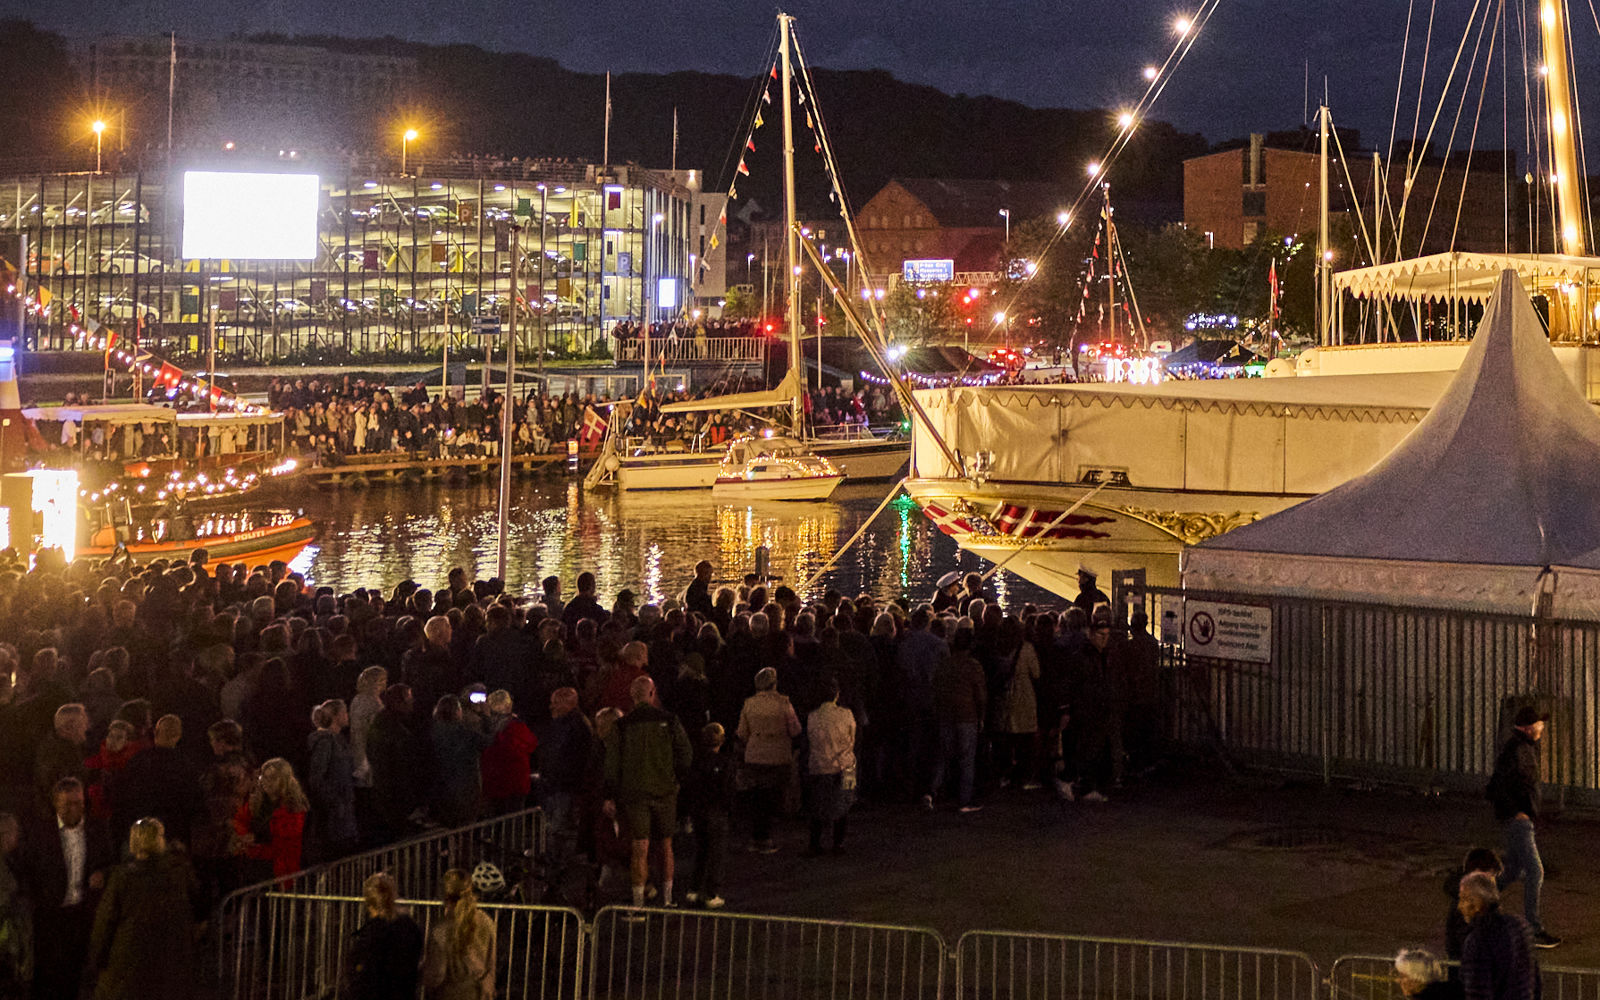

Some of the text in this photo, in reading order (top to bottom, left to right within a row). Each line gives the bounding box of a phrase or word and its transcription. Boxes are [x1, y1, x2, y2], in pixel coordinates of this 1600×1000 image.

[461, 208, 470, 222] P
[620, 256, 628, 269] P
[383, 293, 392, 306] P
[233, 530, 265, 542] POLITI
